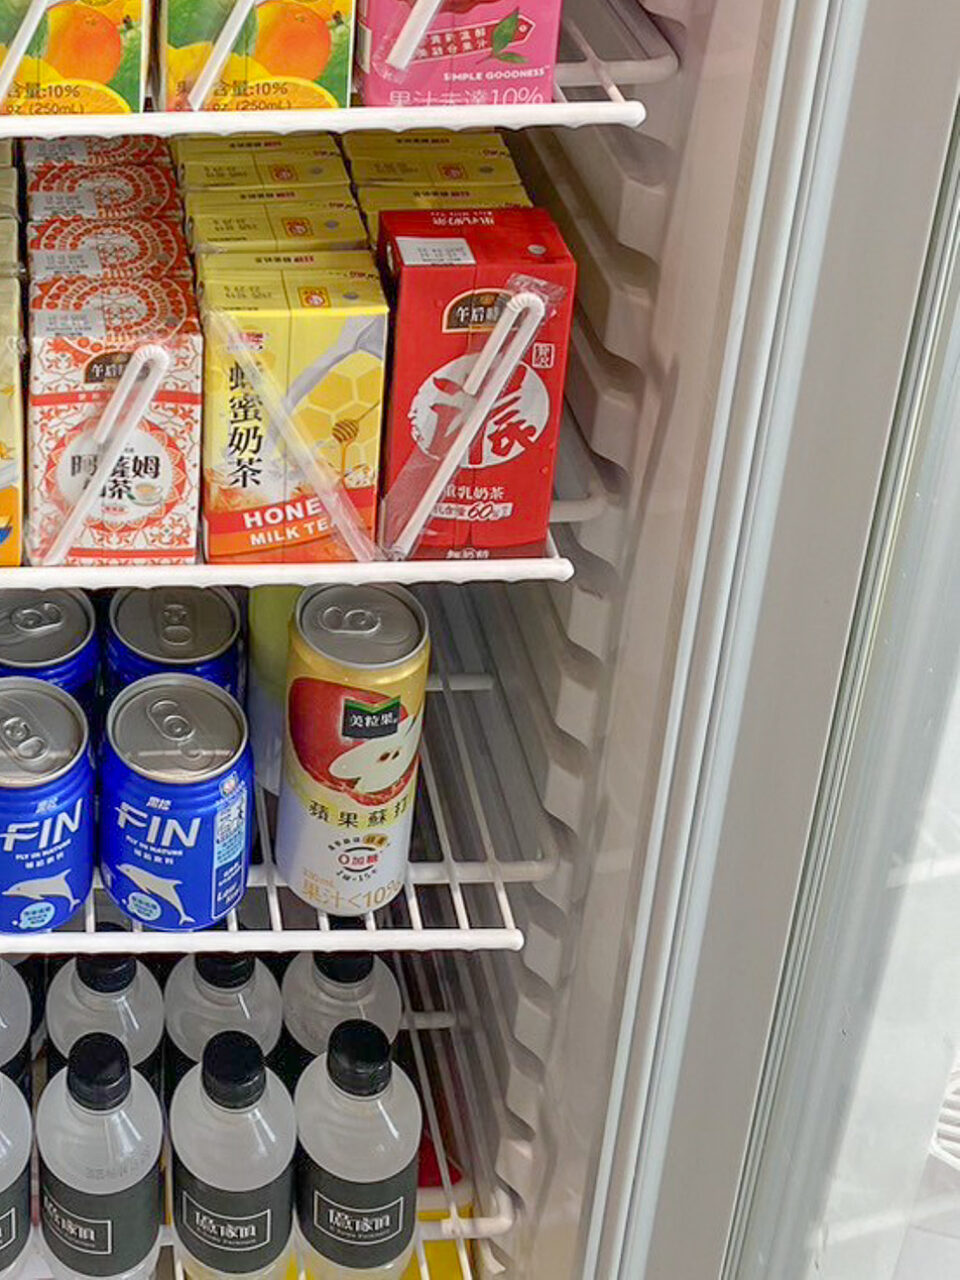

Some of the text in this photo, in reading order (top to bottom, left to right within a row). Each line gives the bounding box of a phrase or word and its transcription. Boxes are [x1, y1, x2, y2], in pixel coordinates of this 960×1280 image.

[443, 68, 545, 81] SIMPLE GOODNESS
[176, 80, 289, 98] 果含量:10%
[242, 498, 324, 530] HONE
[250, 523, 300, 547] MILK
[349, 713, 397, 729] 美粒果
[114, 801, 202, 848] FIN
